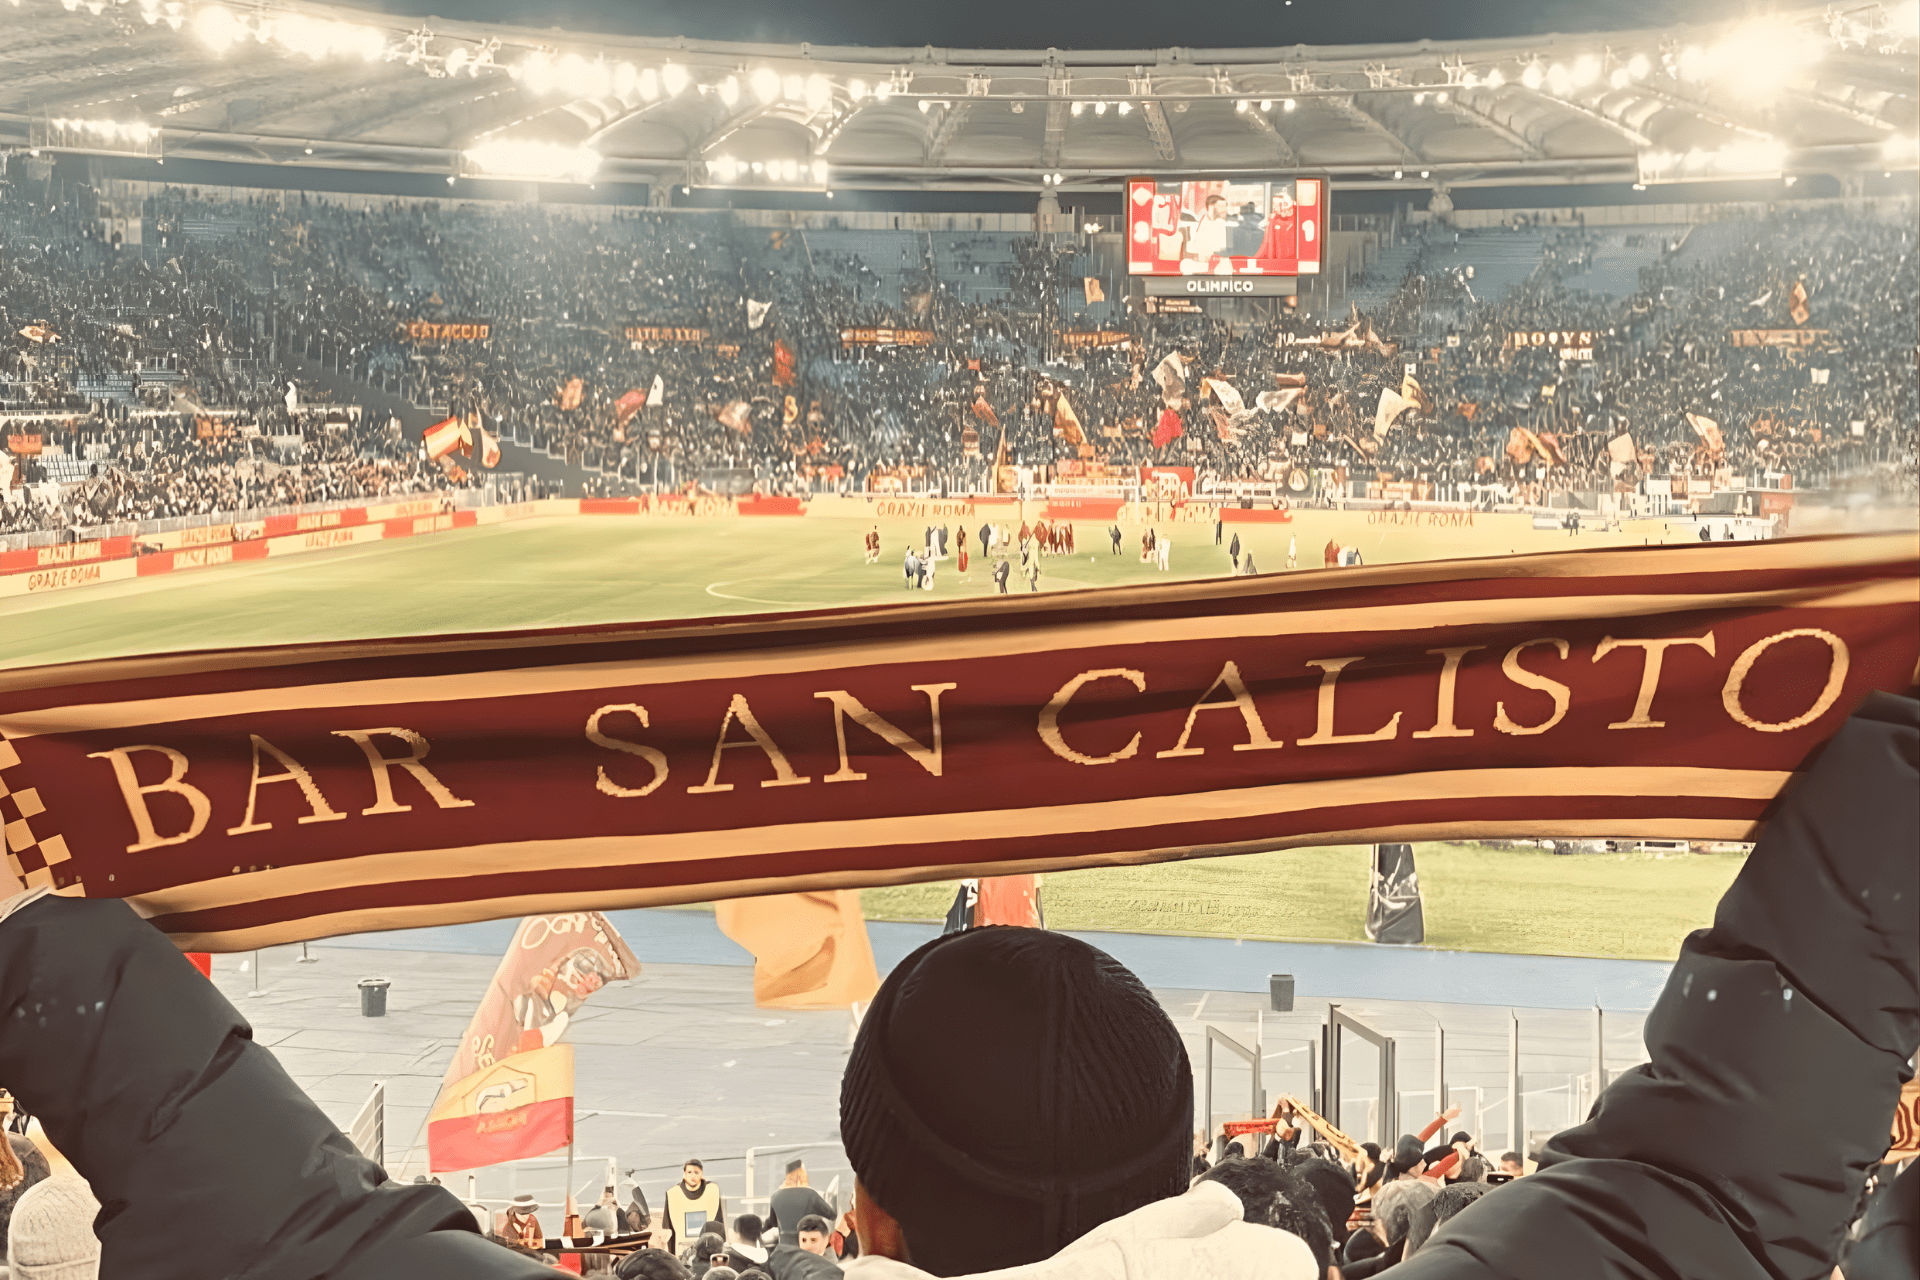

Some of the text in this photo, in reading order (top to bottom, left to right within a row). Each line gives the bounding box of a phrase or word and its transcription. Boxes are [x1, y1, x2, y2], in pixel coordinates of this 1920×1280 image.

[1186, 279, 1254, 293] OLIMPICO
[87, 628, 1850, 854] BAR SAN CALISTO
